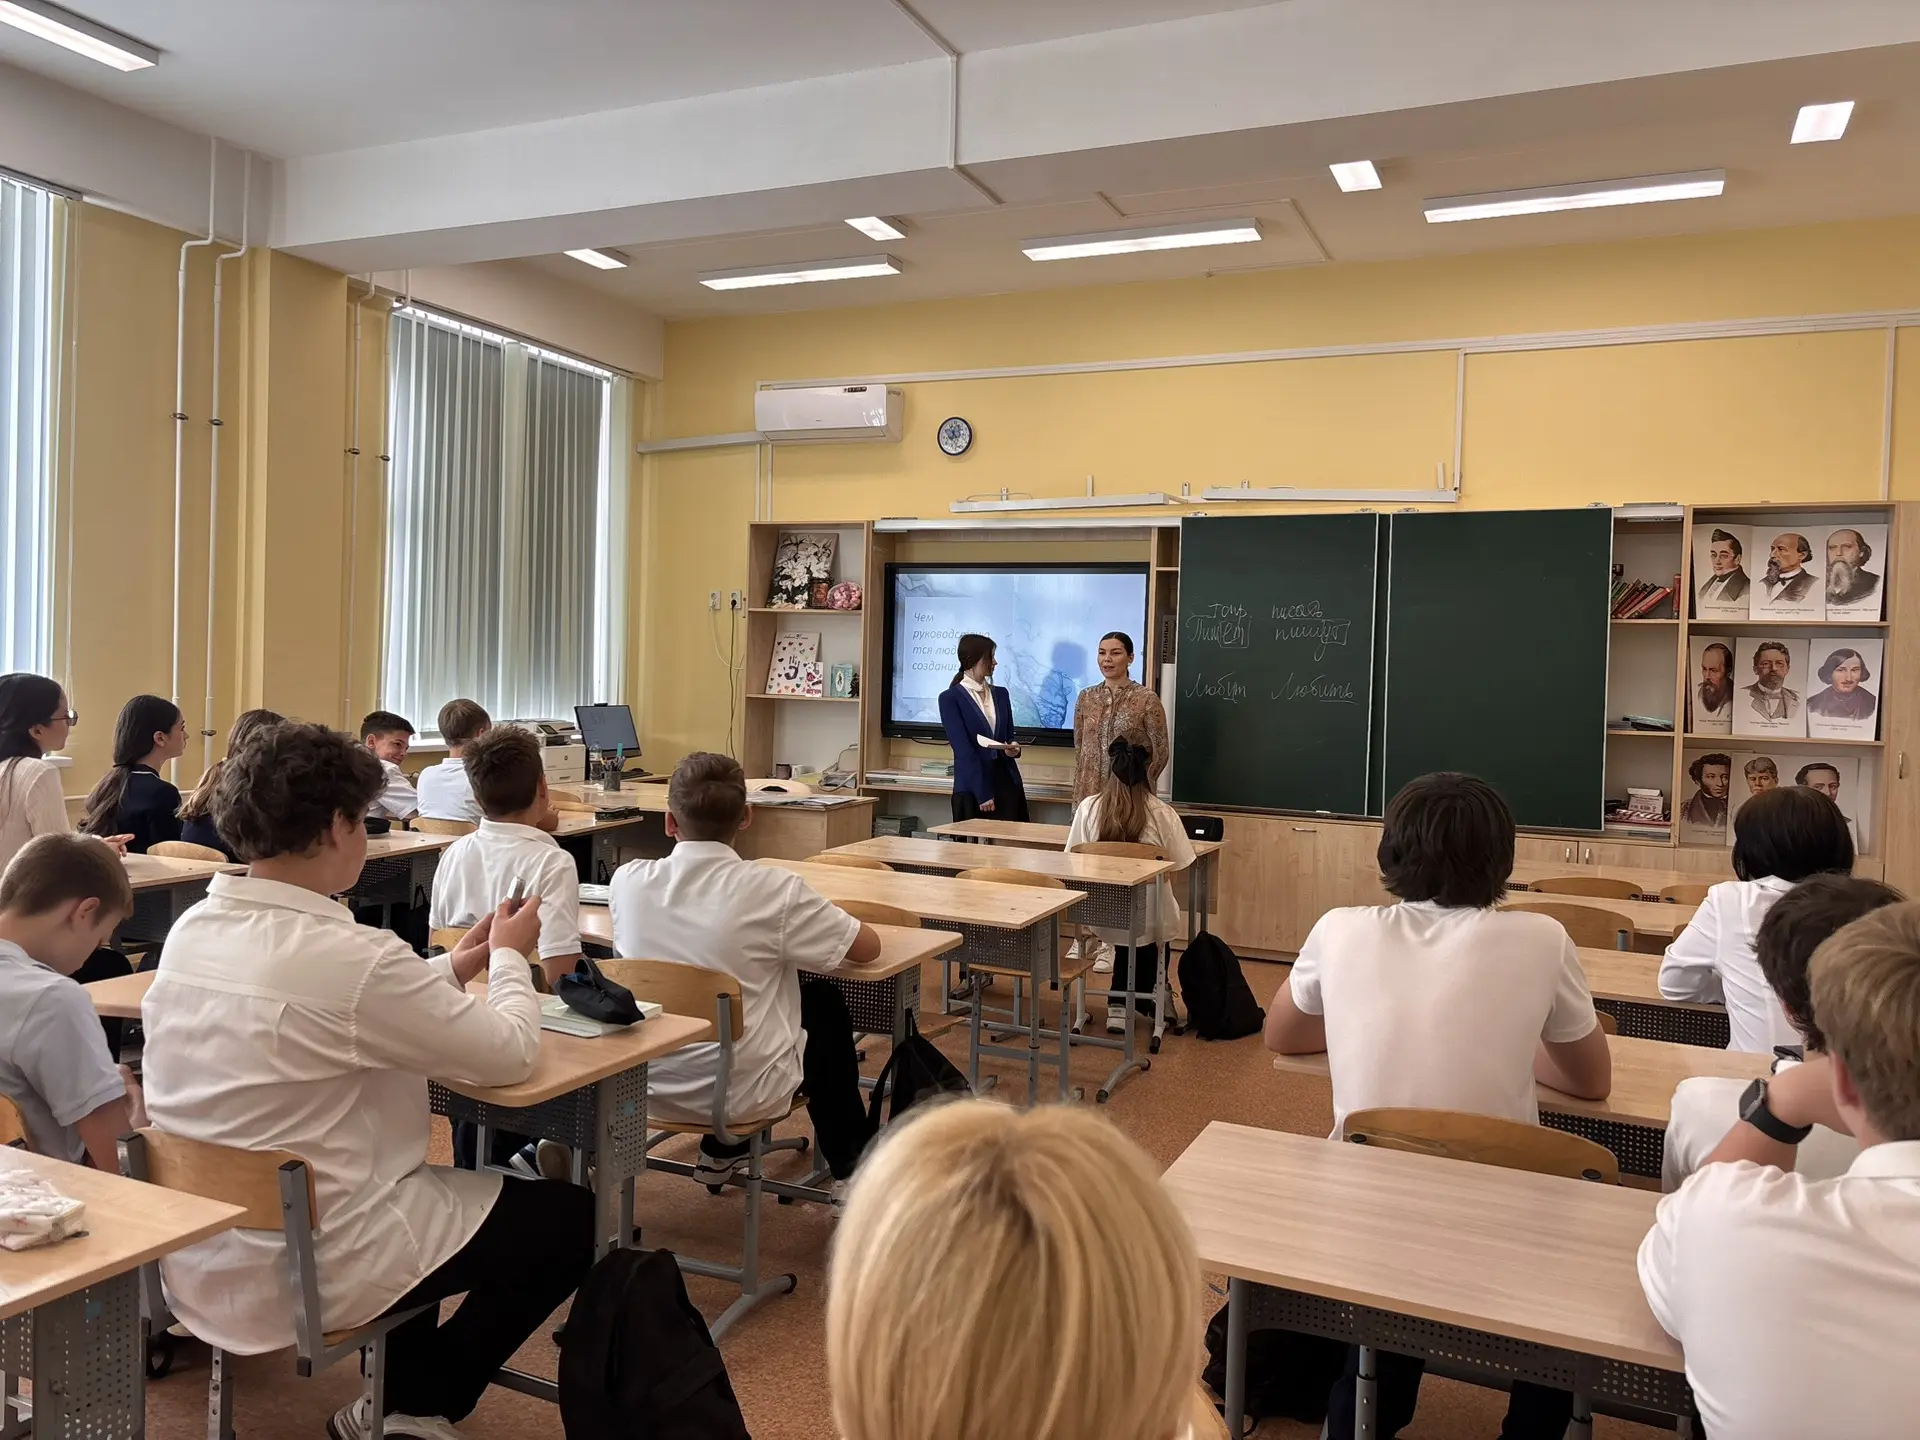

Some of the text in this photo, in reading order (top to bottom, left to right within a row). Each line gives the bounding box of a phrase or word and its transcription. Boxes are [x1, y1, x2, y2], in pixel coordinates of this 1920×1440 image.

[914, 612, 934, 622] Чем
[913, 644, 957, 655] тся люд
